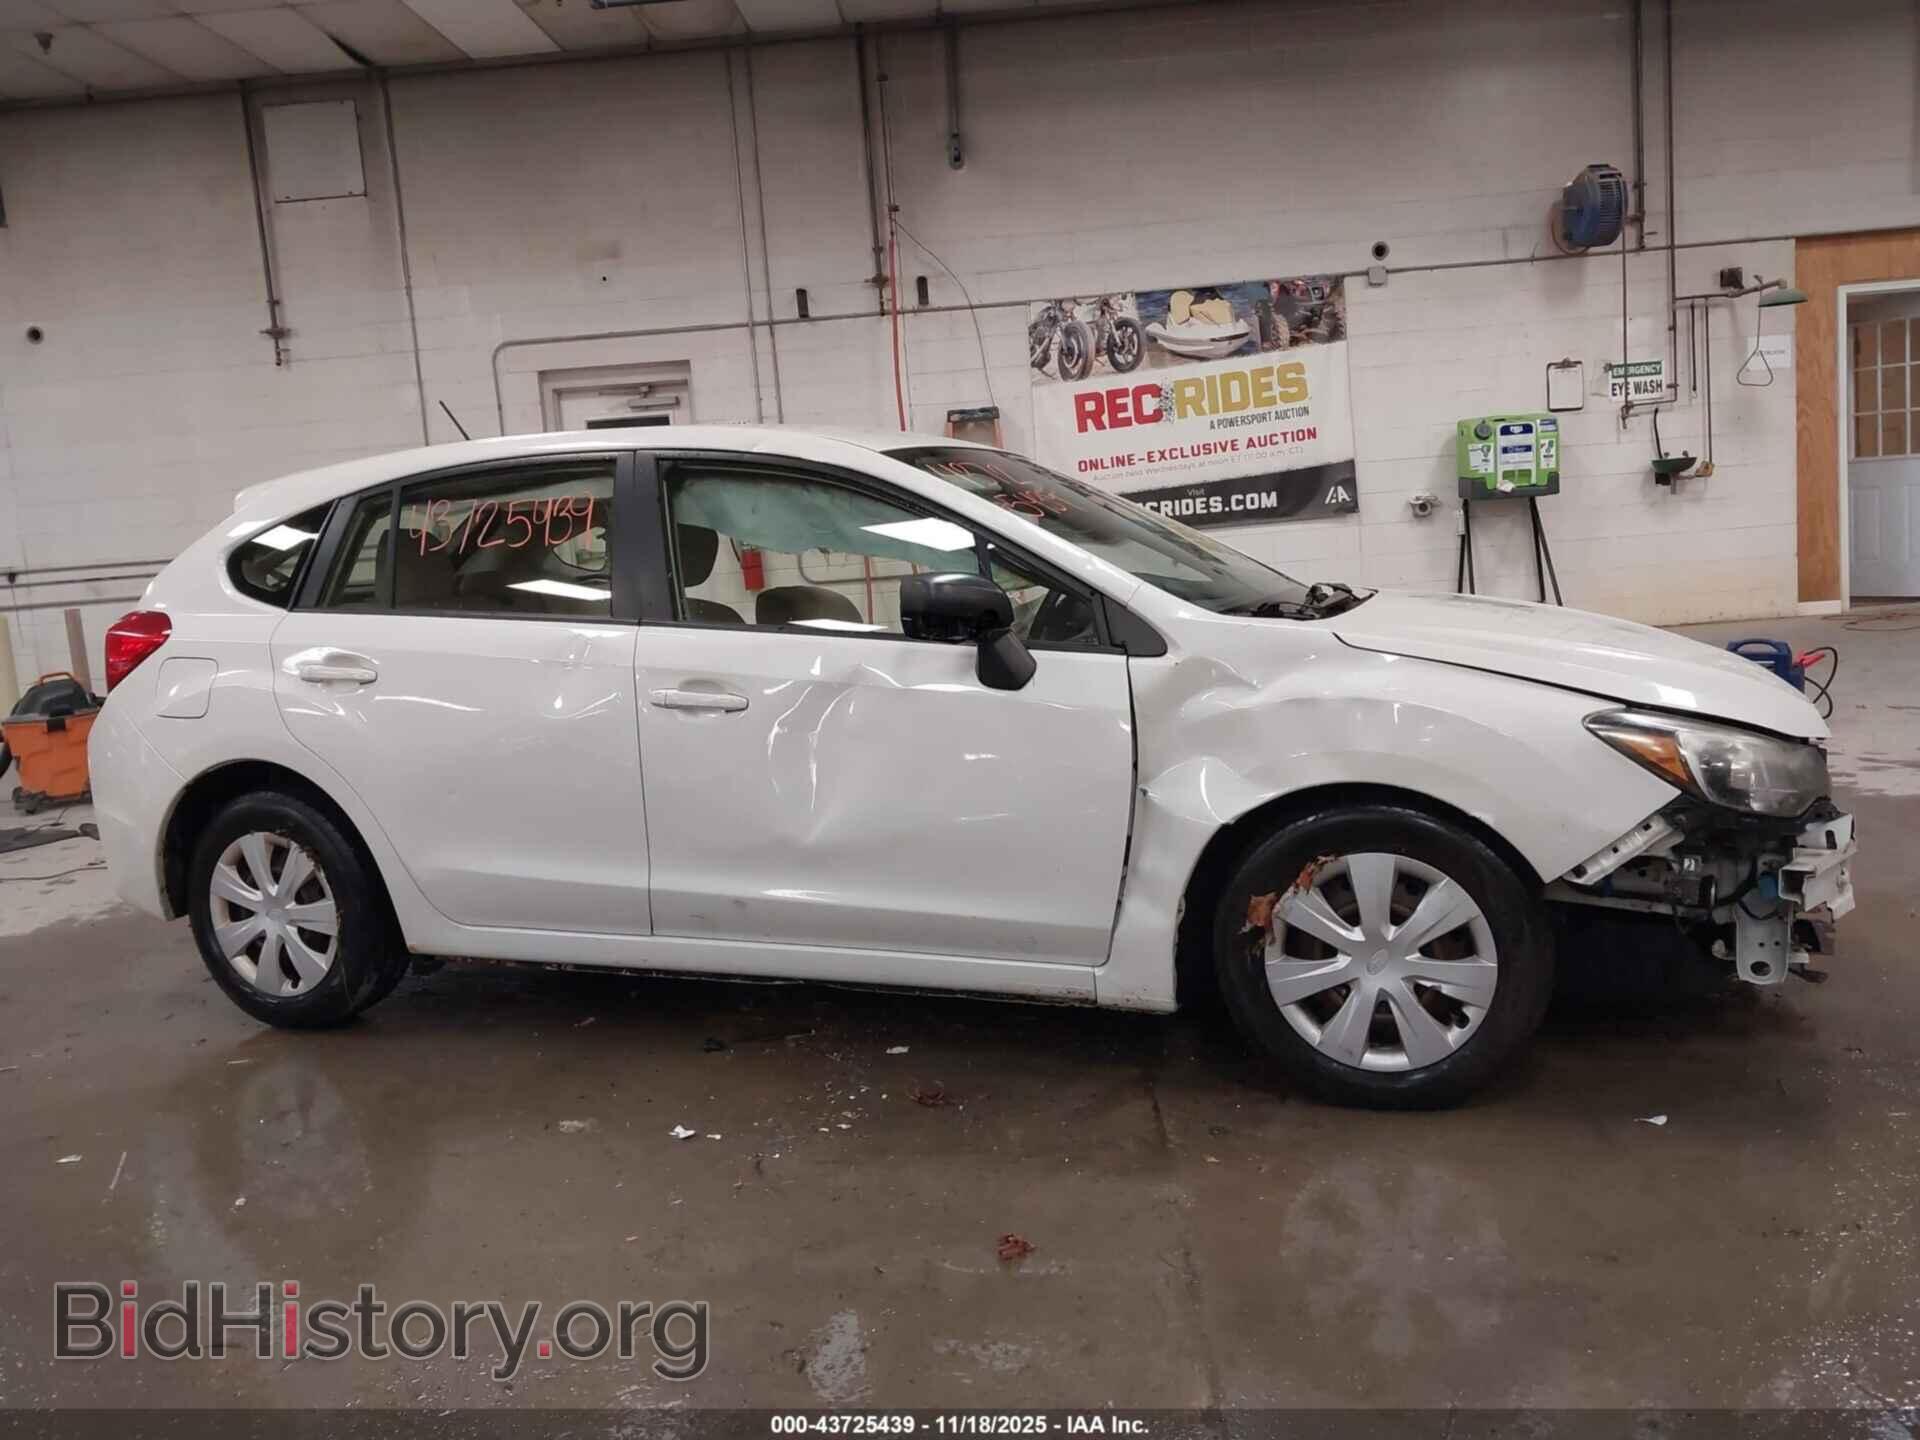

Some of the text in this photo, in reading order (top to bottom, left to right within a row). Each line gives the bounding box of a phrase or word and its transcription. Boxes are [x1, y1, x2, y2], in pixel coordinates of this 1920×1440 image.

[1612, 364, 1662, 376] EMERGENCY
[1074, 362, 1309, 433] REC RIDES
[1611, 379, 1663, 396] EYE WASH
[1209, 406, 1310, 430] A POWERSPORT AUCTION
[1078, 427, 1317, 473] ONLINE-EXCLUSIVE AUCTION
[1137, 491, 1277, 516] CRIDES.COM
[410, 492, 594, 557] 43725439
